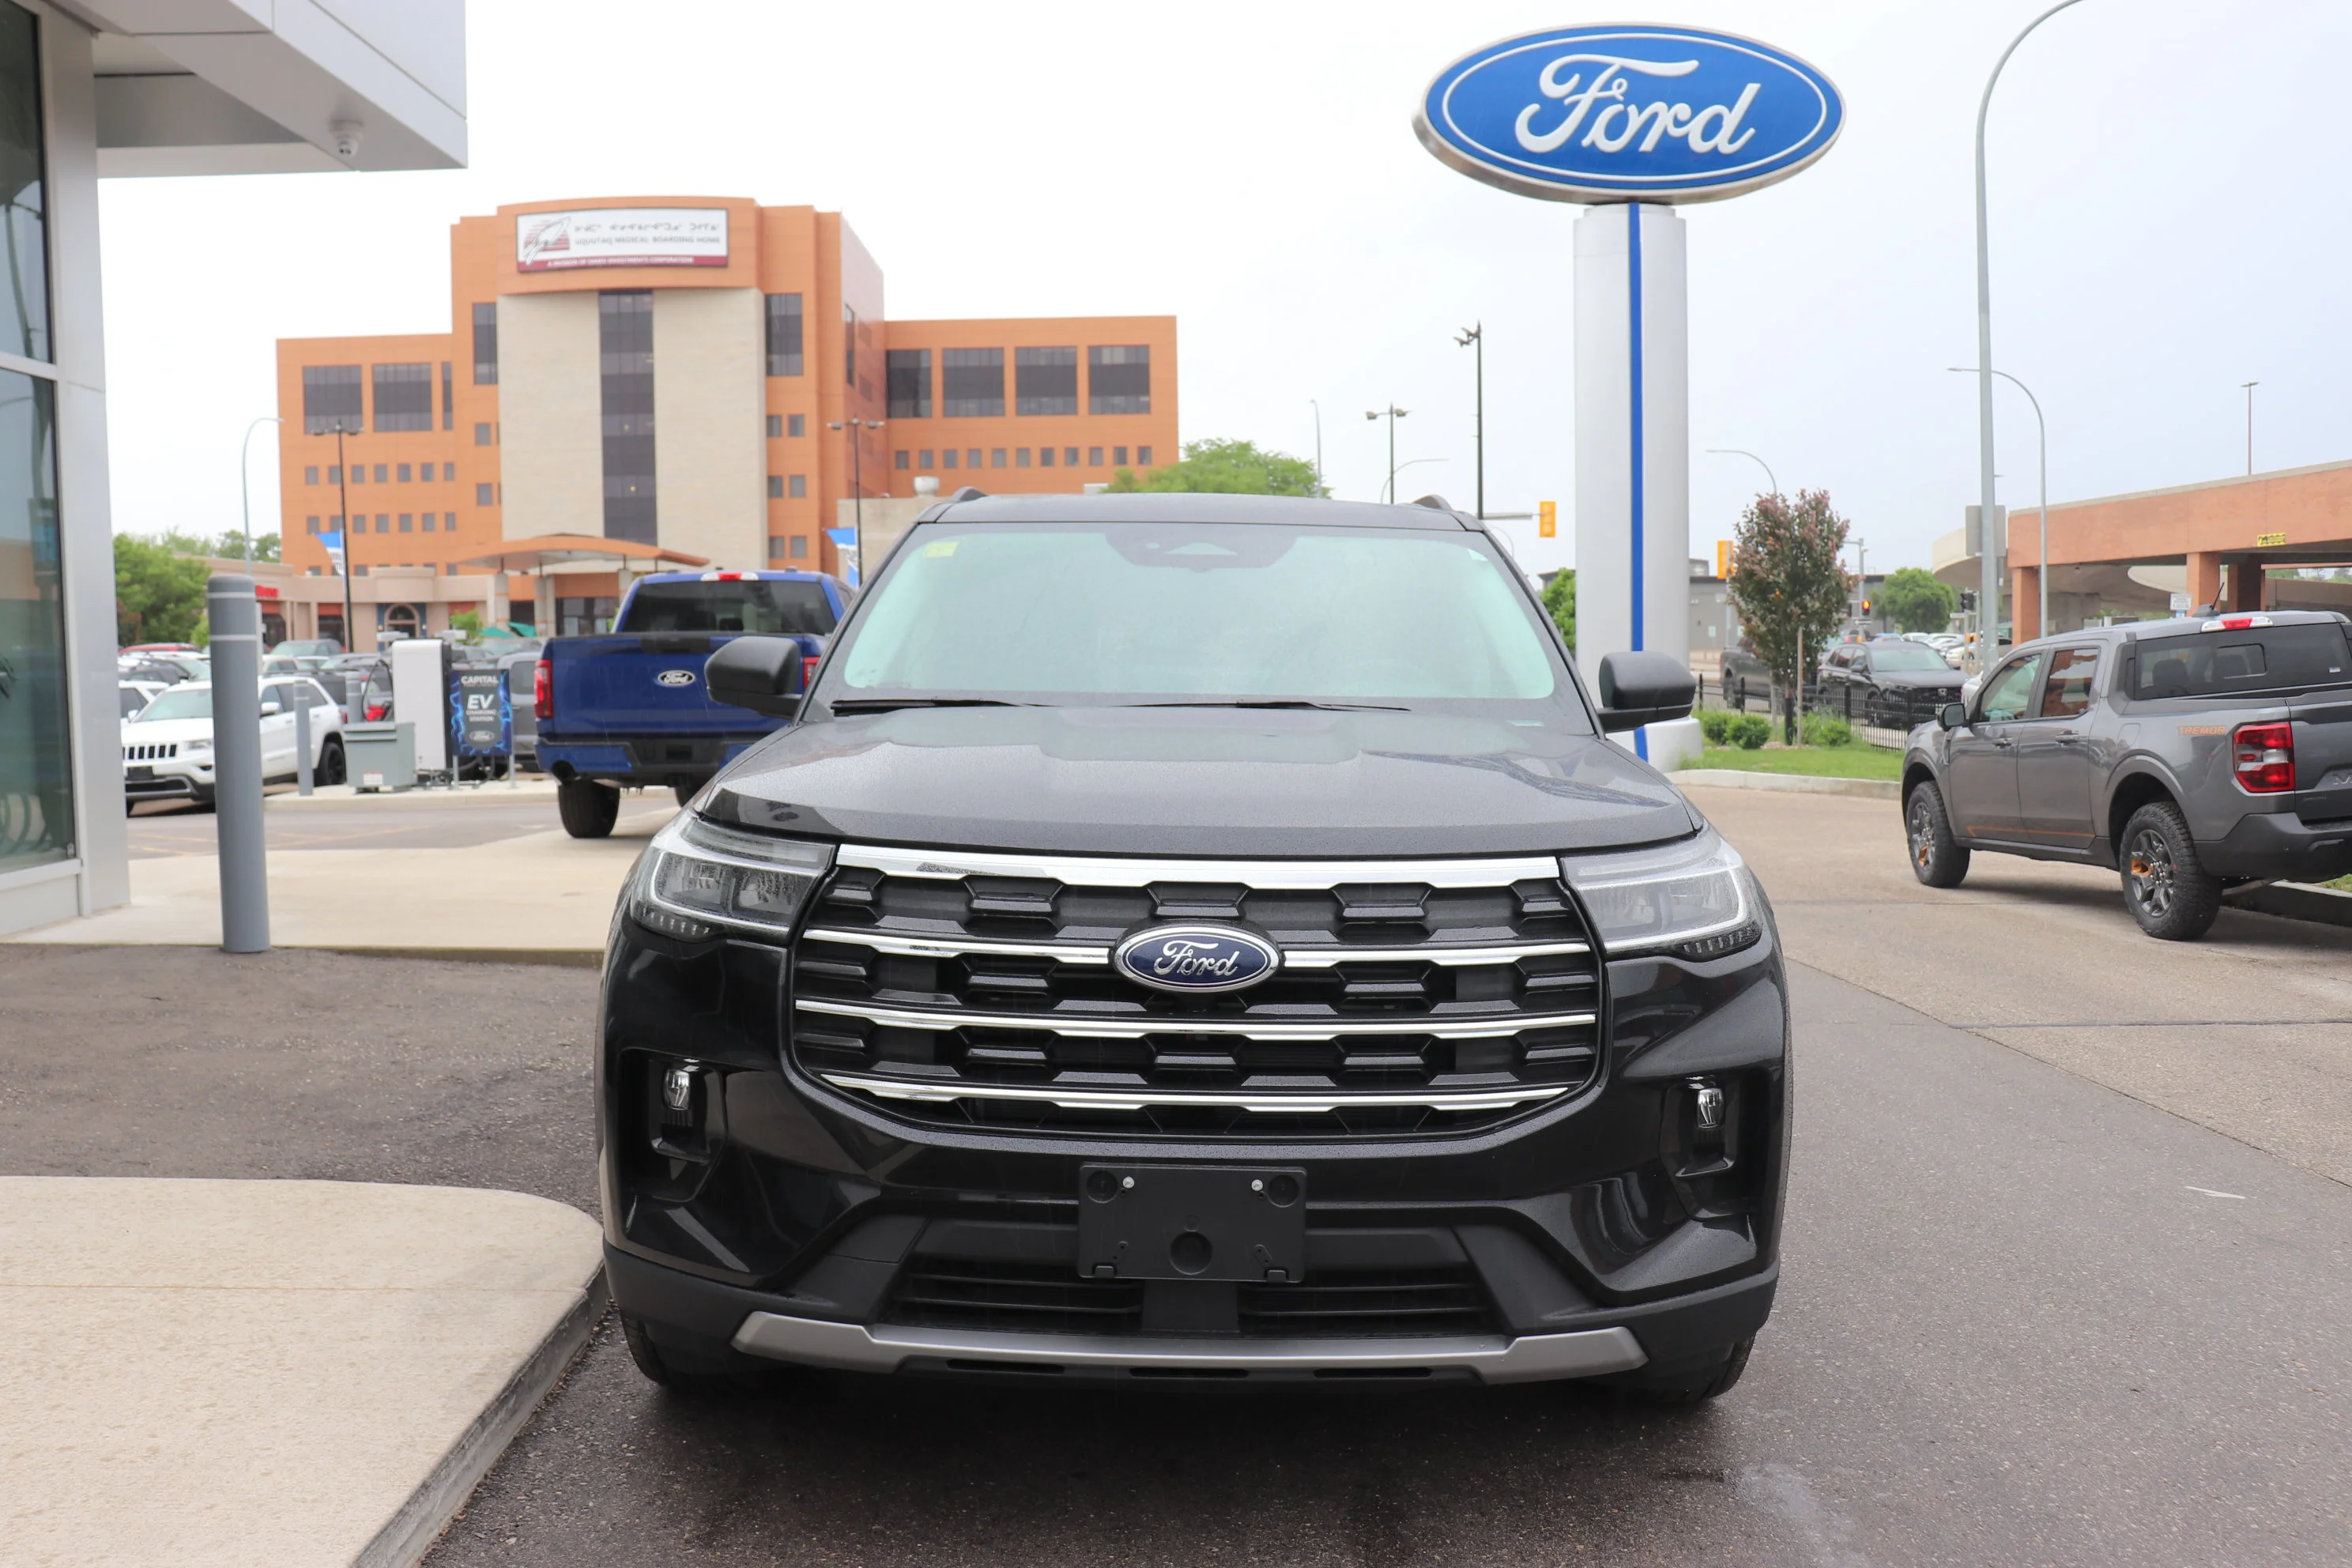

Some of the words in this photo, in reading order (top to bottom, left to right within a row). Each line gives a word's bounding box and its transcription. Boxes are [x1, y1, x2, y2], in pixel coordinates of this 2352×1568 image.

[1515, 54, 1761, 154] Ford
[461, 675, 499, 684] CAPITAL
[467, 694, 495, 709] EV
[2178, 726, 2226, 736] TREMOR
[1154, 940, 1240, 976] Ford
